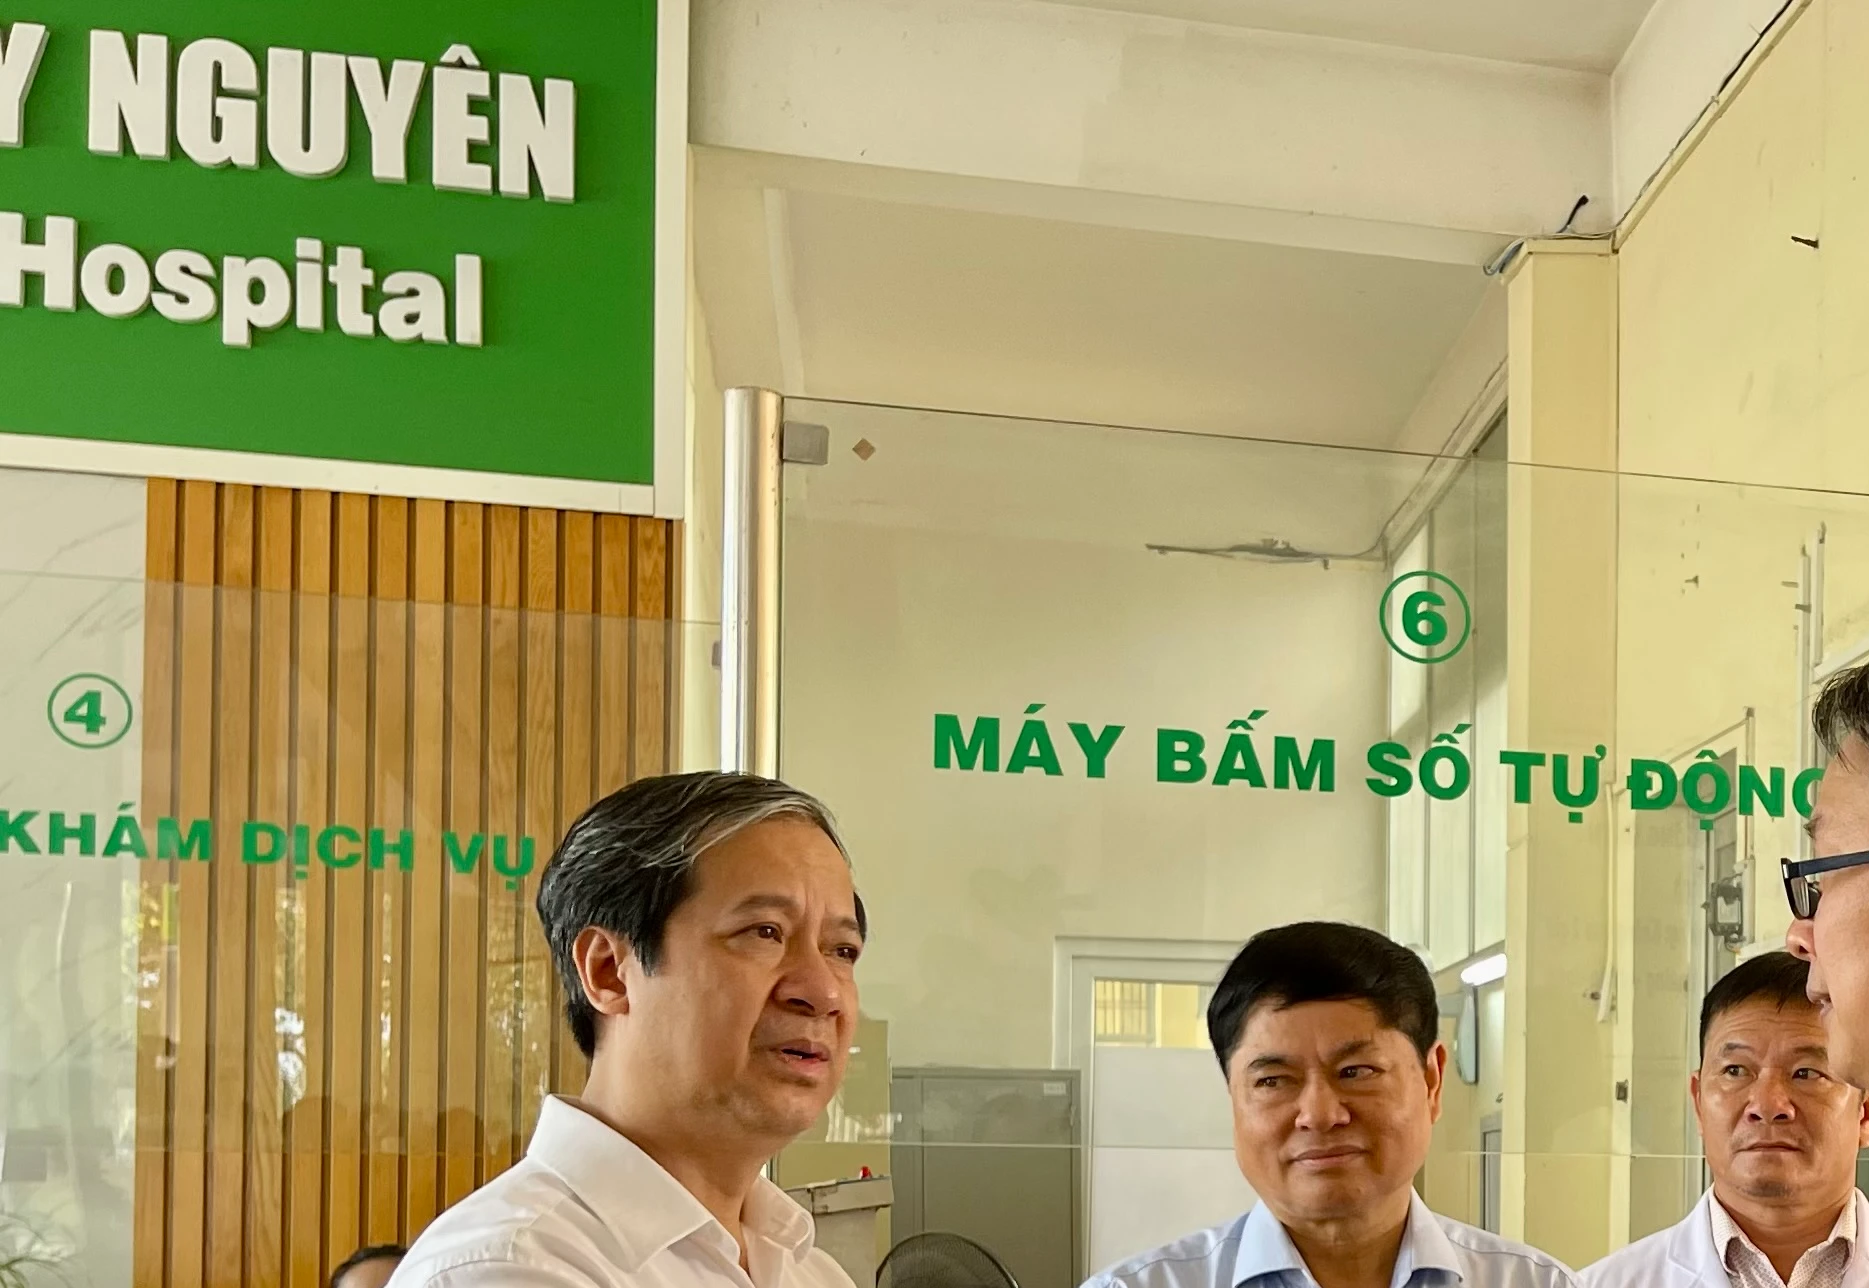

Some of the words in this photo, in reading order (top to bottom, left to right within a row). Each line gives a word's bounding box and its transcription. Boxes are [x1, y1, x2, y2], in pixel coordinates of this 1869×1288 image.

[87, 30, 576, 203] NGUYÊN
[0, 211, 483, 348] Hospital
[1401, 590, 1447, 647] 6
[62, 689, 108, 735] 4
[932, 702, 1125, 780] MÁY
[1155, 708, 1337, 793] BẤM
[1364, 722, 1473, 801] SỐ
[1497, 743, 1608, 825] TỰ
[0, 801, 214, 863] KHÁM
[241, 820, 416, 880] DỊCH
[442, 829, 537, 891] VỤ
